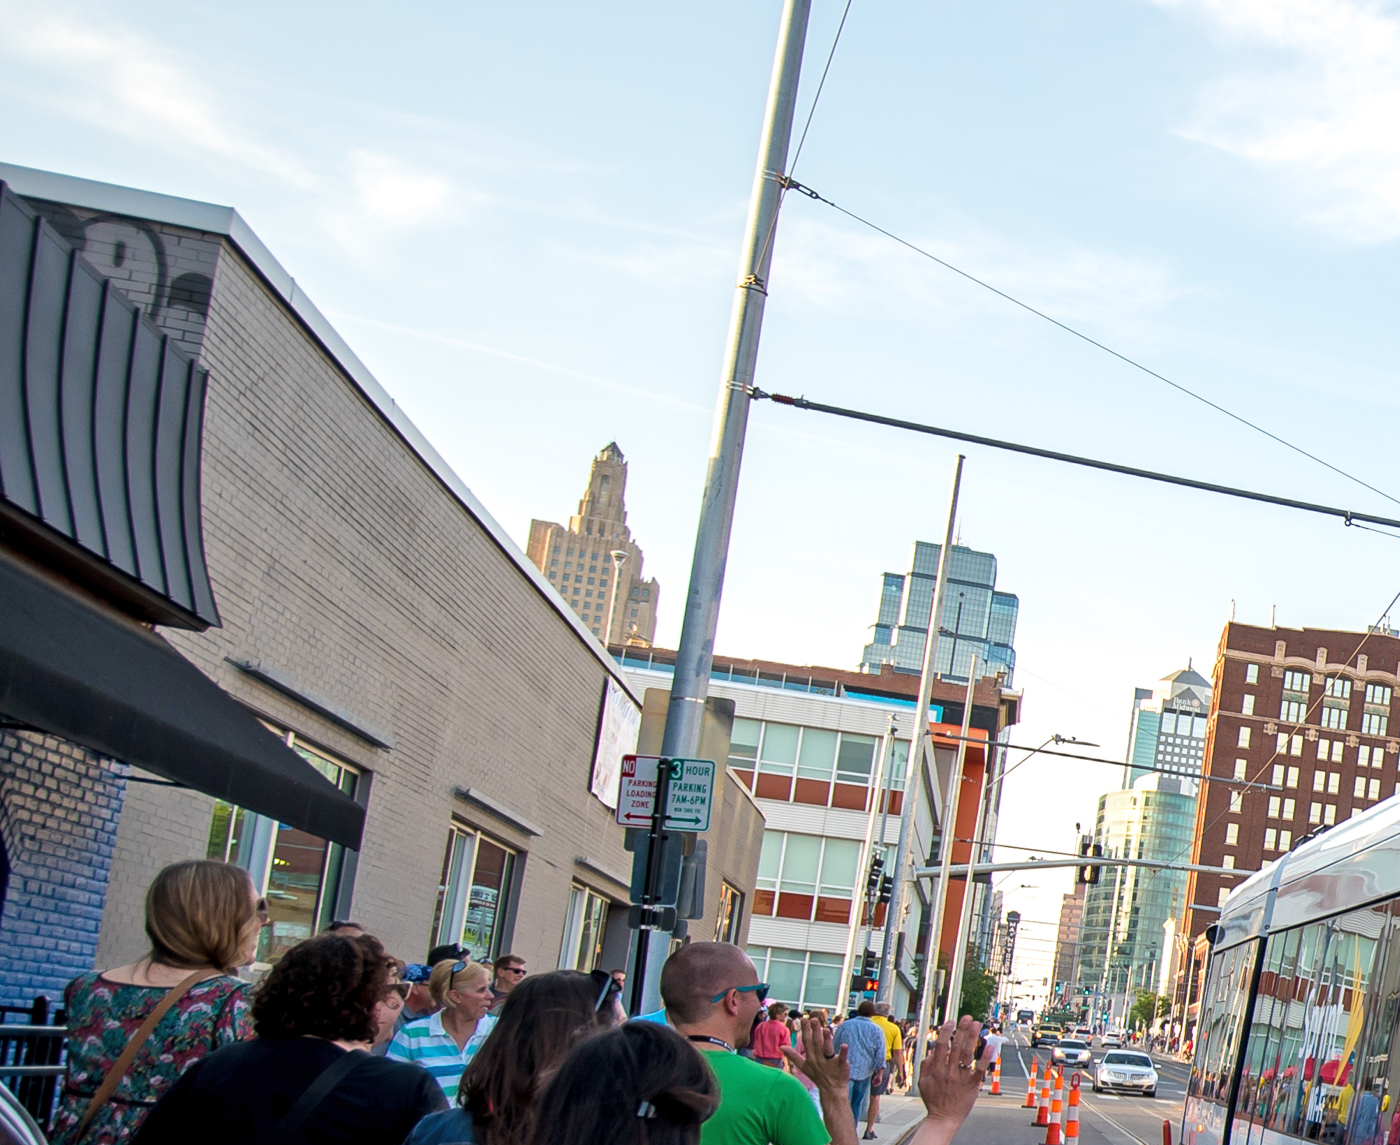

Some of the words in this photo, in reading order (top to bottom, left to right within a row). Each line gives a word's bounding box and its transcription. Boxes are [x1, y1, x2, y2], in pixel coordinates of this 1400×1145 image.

[622, 760, 635, 774] NO
[671, 760, 682, 779] 3
[685, 766, 710, 776] HOUR
[628, 779, 657, 788] PARKING
[673, 782, 707, 793] PARKING
[627, 789, 656, 799] LOADING
[672, 794, 706, 805] 7AM-6PM
[631, 800, 650, 808] ZONE
